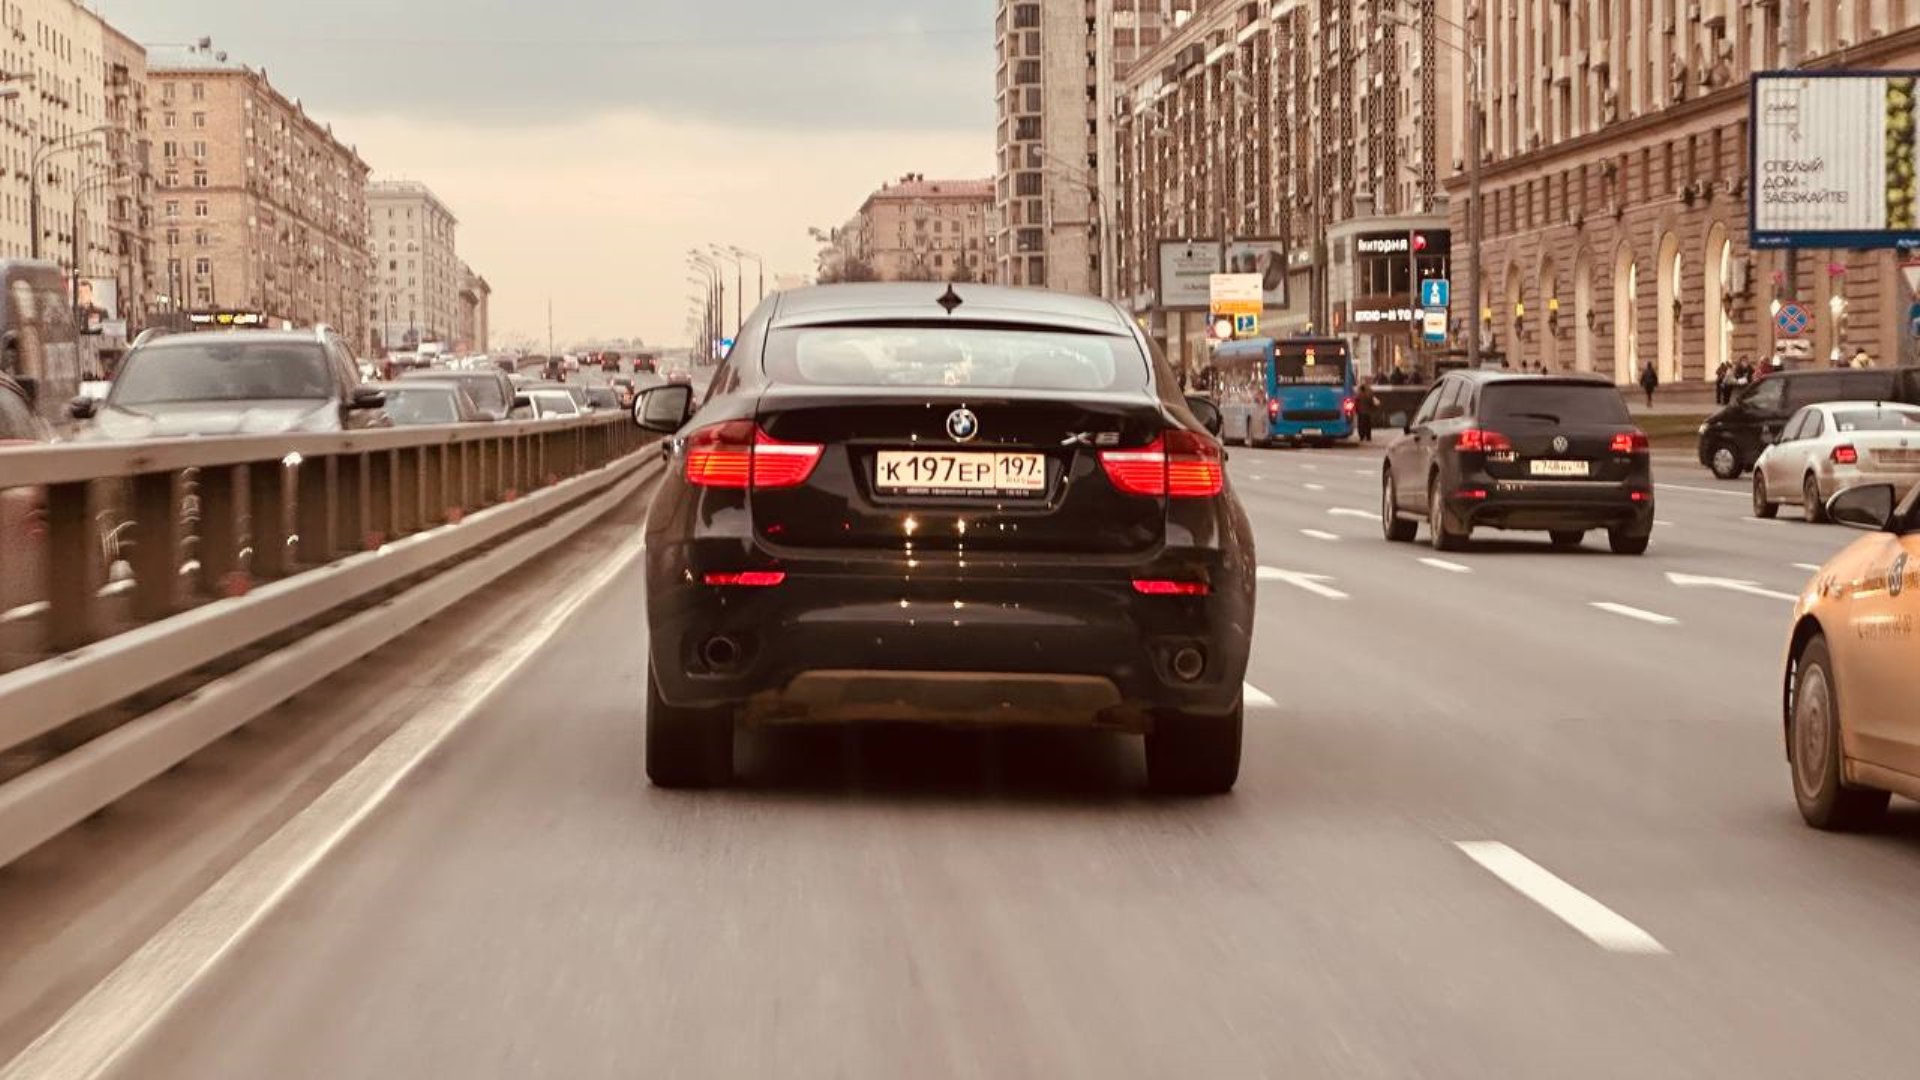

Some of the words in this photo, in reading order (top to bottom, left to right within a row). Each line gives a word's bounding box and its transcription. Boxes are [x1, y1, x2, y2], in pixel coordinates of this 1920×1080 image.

[1763, 157, 1825, 173] СПЕЛЫЙ
[1763, 175, 1798, 189] ДОМ
[999, 456, 1037, 476] 197
